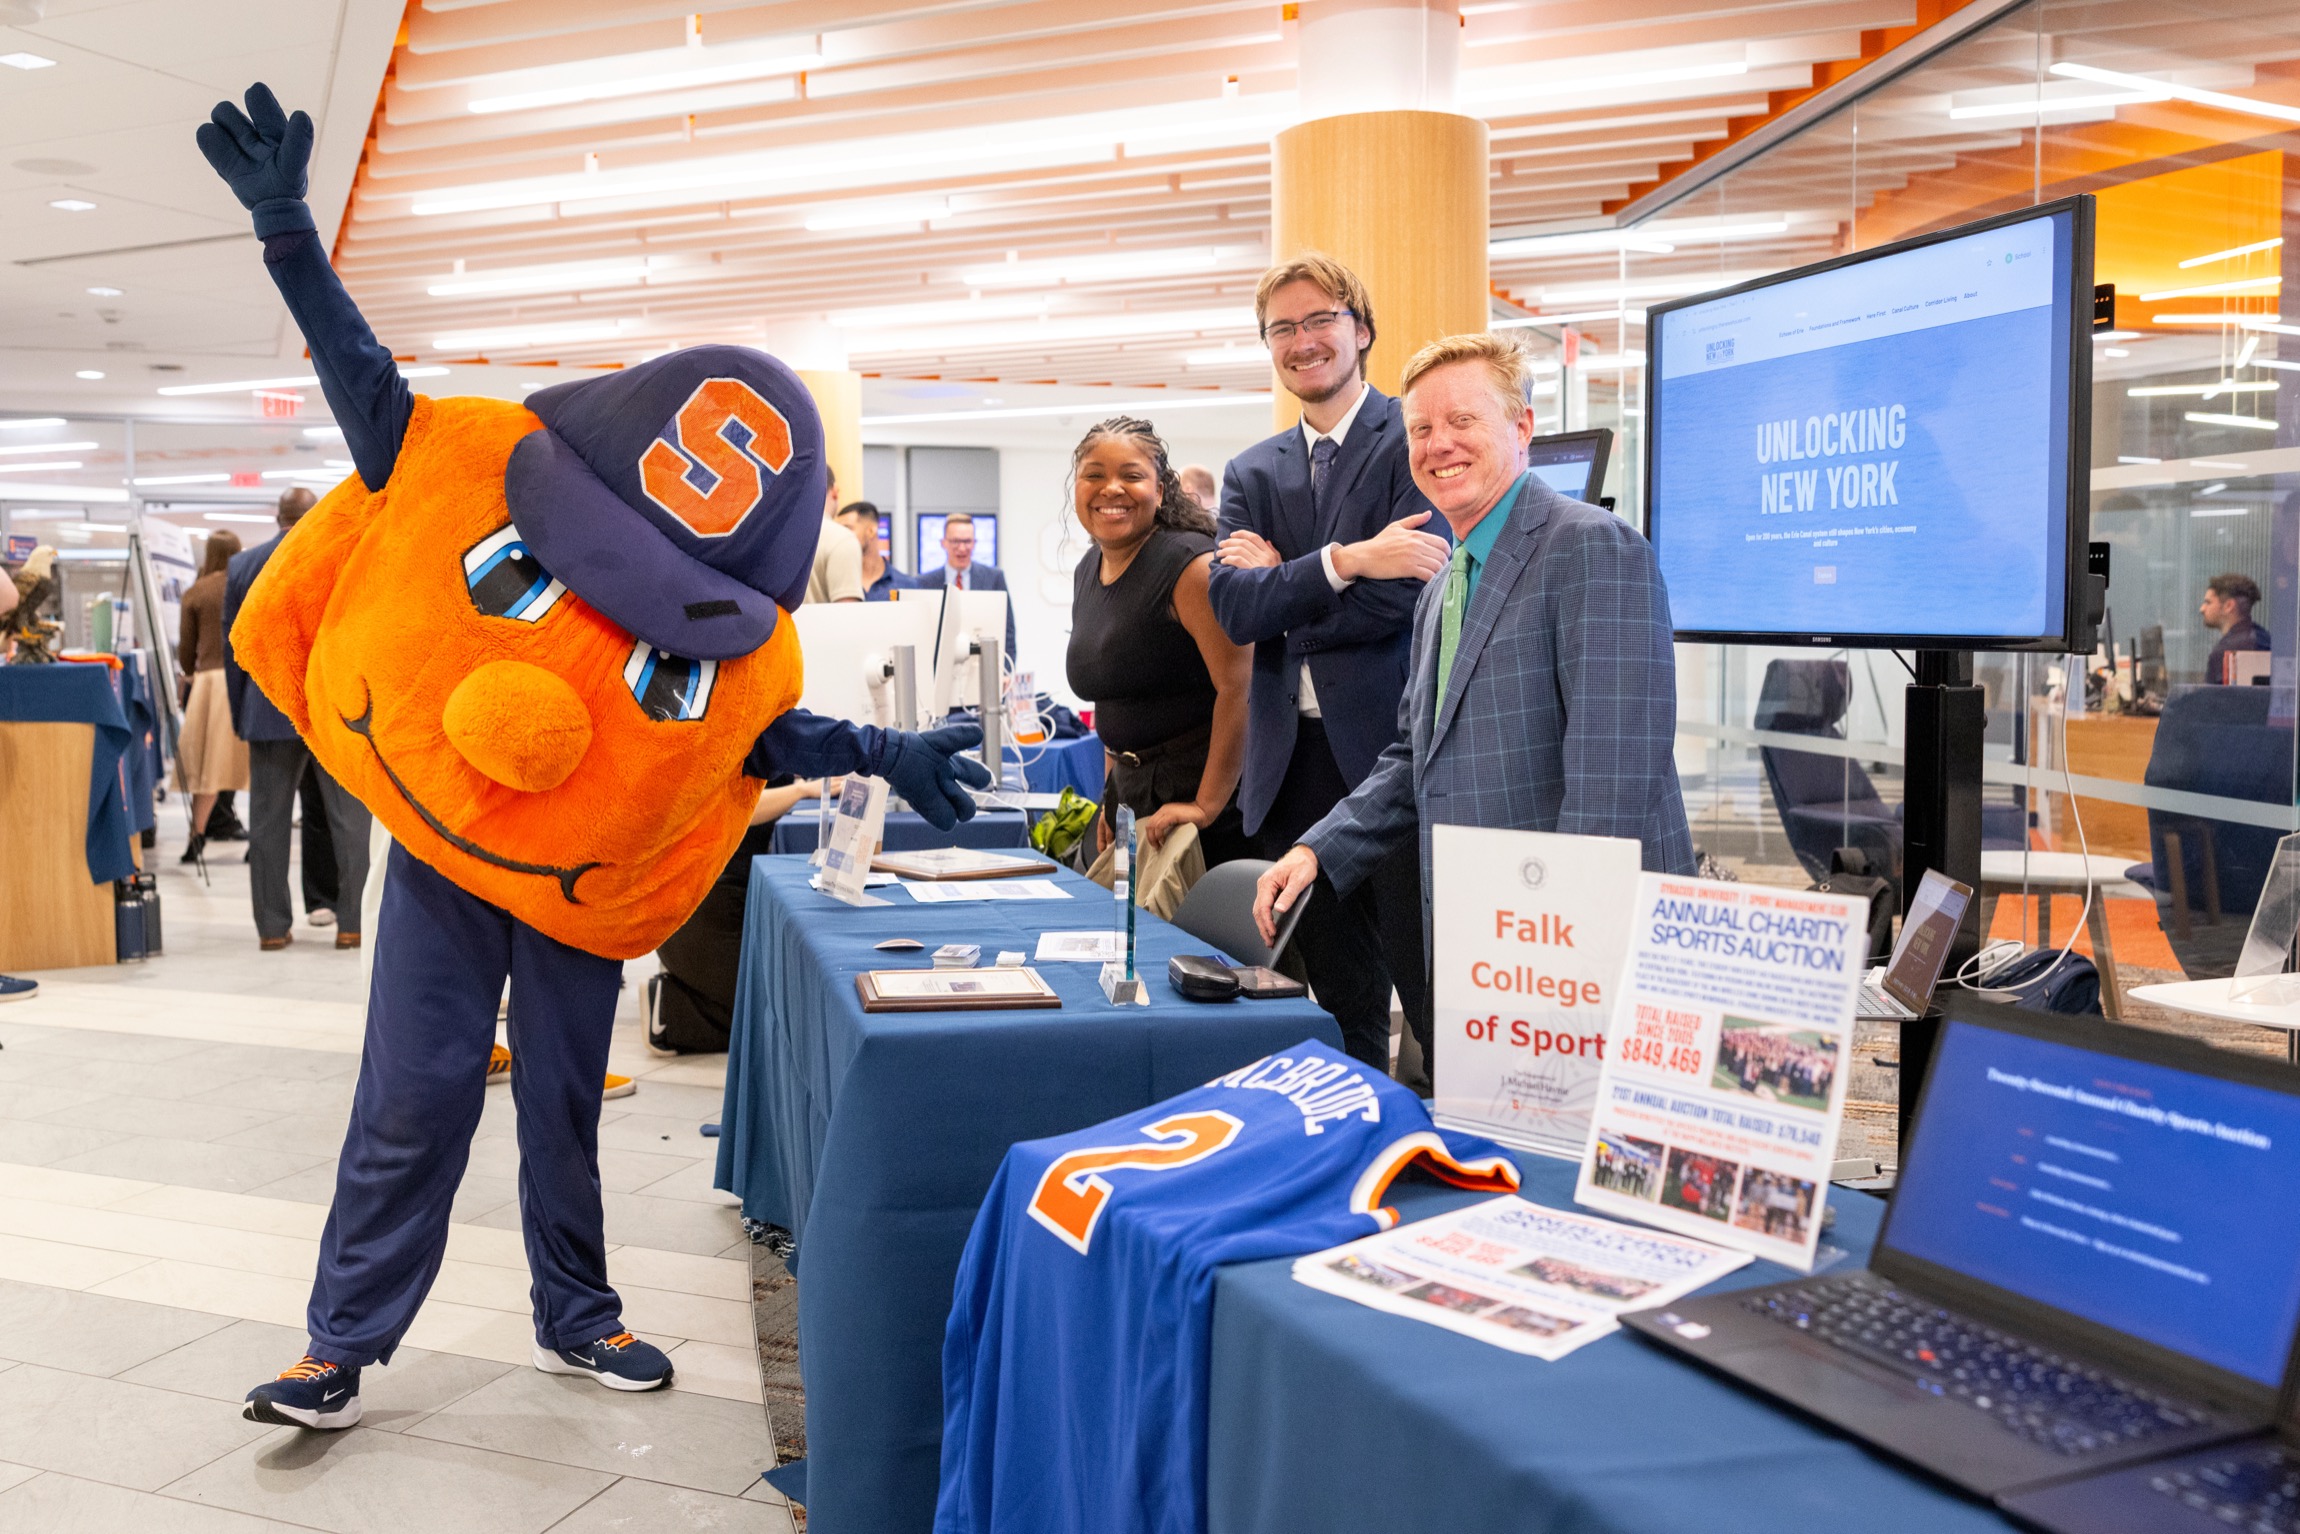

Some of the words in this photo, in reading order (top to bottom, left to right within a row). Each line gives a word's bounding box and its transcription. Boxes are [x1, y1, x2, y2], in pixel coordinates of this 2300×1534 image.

[1904, 304, 1919, 312] Culture
[1925, 299, 1943, 307] Corridor
[1943, 296, 1957, 304] Living
[1964, 291, 1978, 299] About
[1809, 323, 1831, 331] Foundations
[1840, 316, 1861, 325] Framework
[1706, 338, 1735, 352] UNLOCKING
[1706, 351, 1716, 360] NEW
[1723, 348, 1734, 358] YORK
[1757, 403, 1906, 464] UNLOCKING
[638, 377, 794, 538] S
[1761, 469, 1818, 515] NEW
[1826, 460, 1899, 510] YORK
[1800, 530, 1813, 538] Canal
[1813, 530, 1828, 539] system
[1828, 528, 1837, 536] still
[1838, 528, 1853, 537] shapes
[1854, 527, 1864, 535] New
[1865, 526, 1878, 534] York's
[1880, 525, 1894, 534] cities,
[1895, 525, 1917, 534] economy
[1813, 539, 1821, 547] and
[1822, 539, 1838, 547] culture
[1698, 887, 1739, 901] UNIVERSITY
[1495, 909, 1575, 948] Falk
[1652, 898, 1744, 931] ANNUAL
[1749, 911, 1849, 944] CHARITY
[1650, 923, 1738, 956] SPORTS
[1738, 937, 1845, 972] AUCTION
[1471, 961, 1601, 1007] College
[1636, 1004, 1662, 1022] TOTAL
[1665, 1009, 1702, 1030] RAISED
[1636, 1021, 1664, 1041] SINCE
[1465, 1015, 1499, 1042] of
[1510, 1020, 1606, 1060] Sport
[1621, 1038, 1701, 1075] $849,469
[1633, 1089, 1666, 1112] ANNUAL
[1670, 1098, 1708, 1119] AUCTION
[1711, 1107, 1736, 1127] TOTAL
[1026, 1109, 1245, 1256] 2
